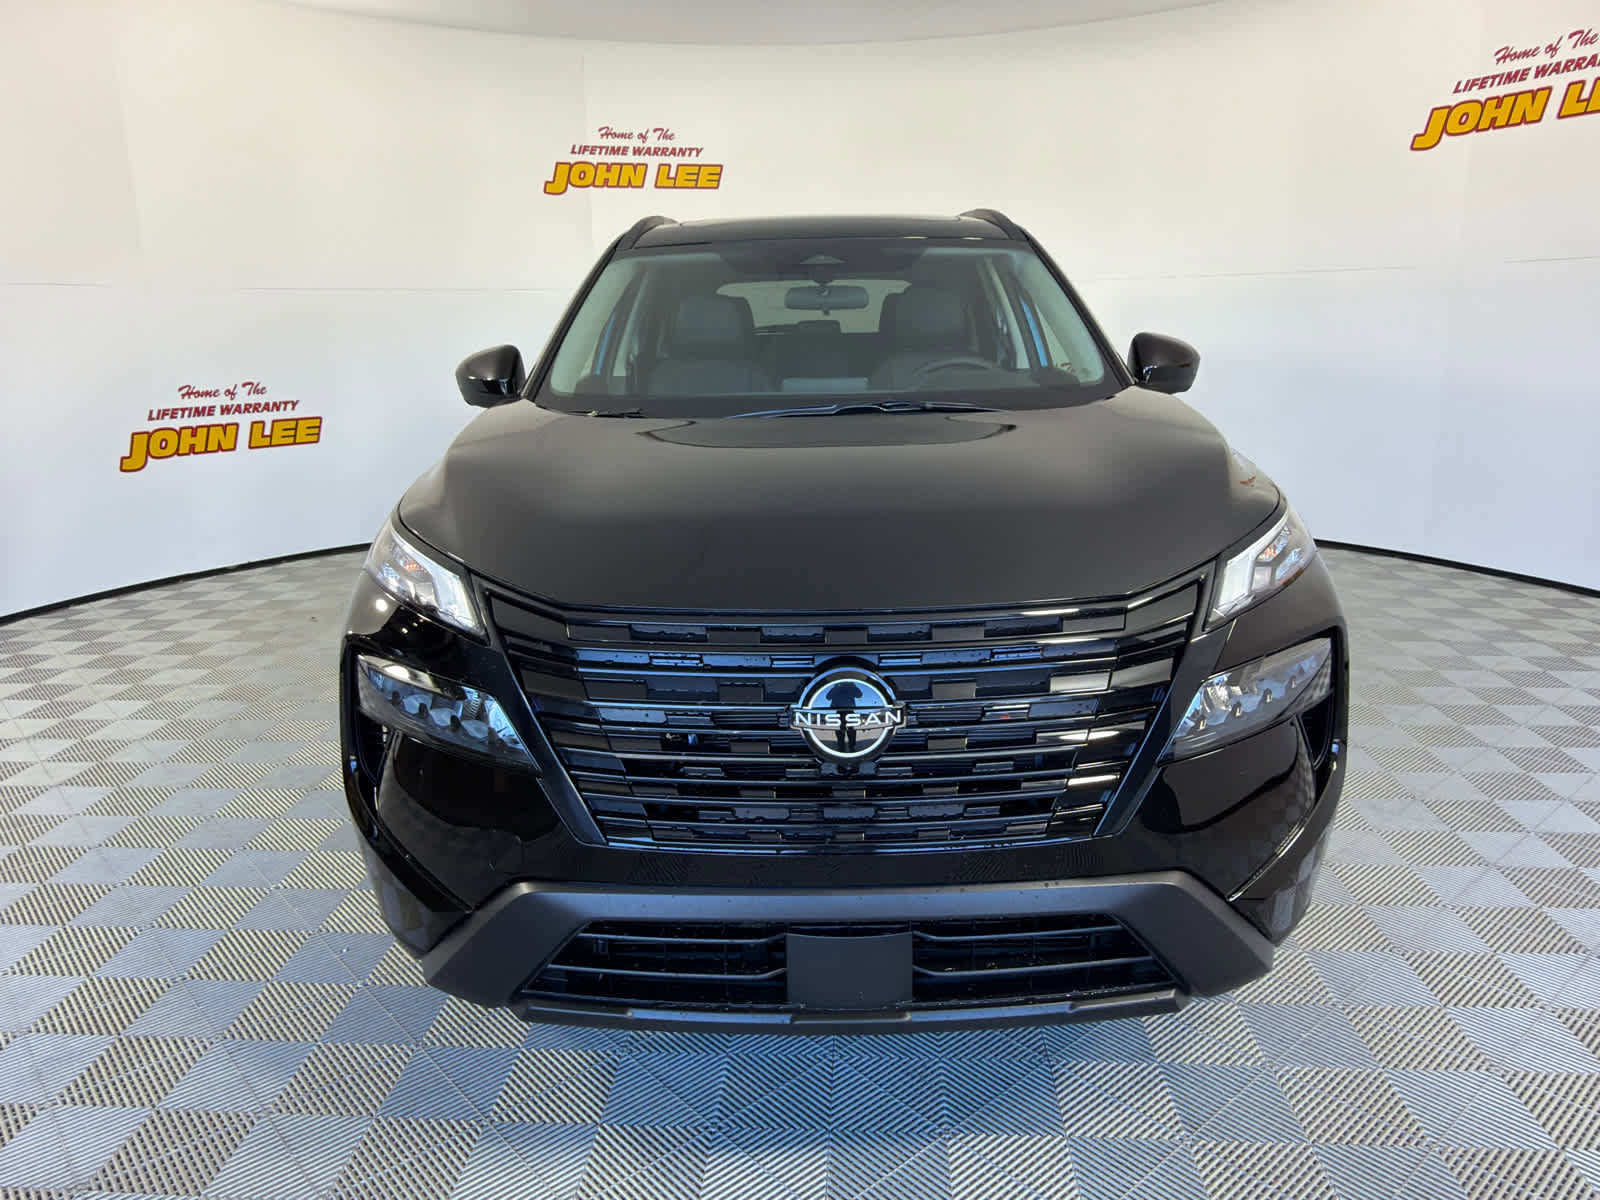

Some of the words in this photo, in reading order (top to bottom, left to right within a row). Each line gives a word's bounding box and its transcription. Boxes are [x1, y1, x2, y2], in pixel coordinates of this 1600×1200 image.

[1494, 45, 1540, 65] Home
[1544, 35, 1563, 58] of
[1568, 28, 1600, 49] The
[1453, 67, 1531, 94] LIFETIME
[1533, 53, 1600, 79] WARRA
[1410, 86, 1553, 151] JOHN
[598, 126, 633, 141] Home
[637, 129, 649, 143] of
[652, 127, 675, 141] The
[570, 144, 630, 156] LIFETIME
[632, 146, 704, 158] WARRANTY
[543, 161, 649, 196] JOHN
[654, 163, 724, 190] LEE
[178, 384, 220, 399] Home
[224, 384, 238, 400] of
[241, 381, 267, 397] The
[147, 405, 216, 421] LIFETIME
[219, 400, 299, 416] WARRANTY
[119, 422, 239, 473] JOHN
[248, 416, 323, 450] LEE
[795, 709, 901, 727] NISSAN
